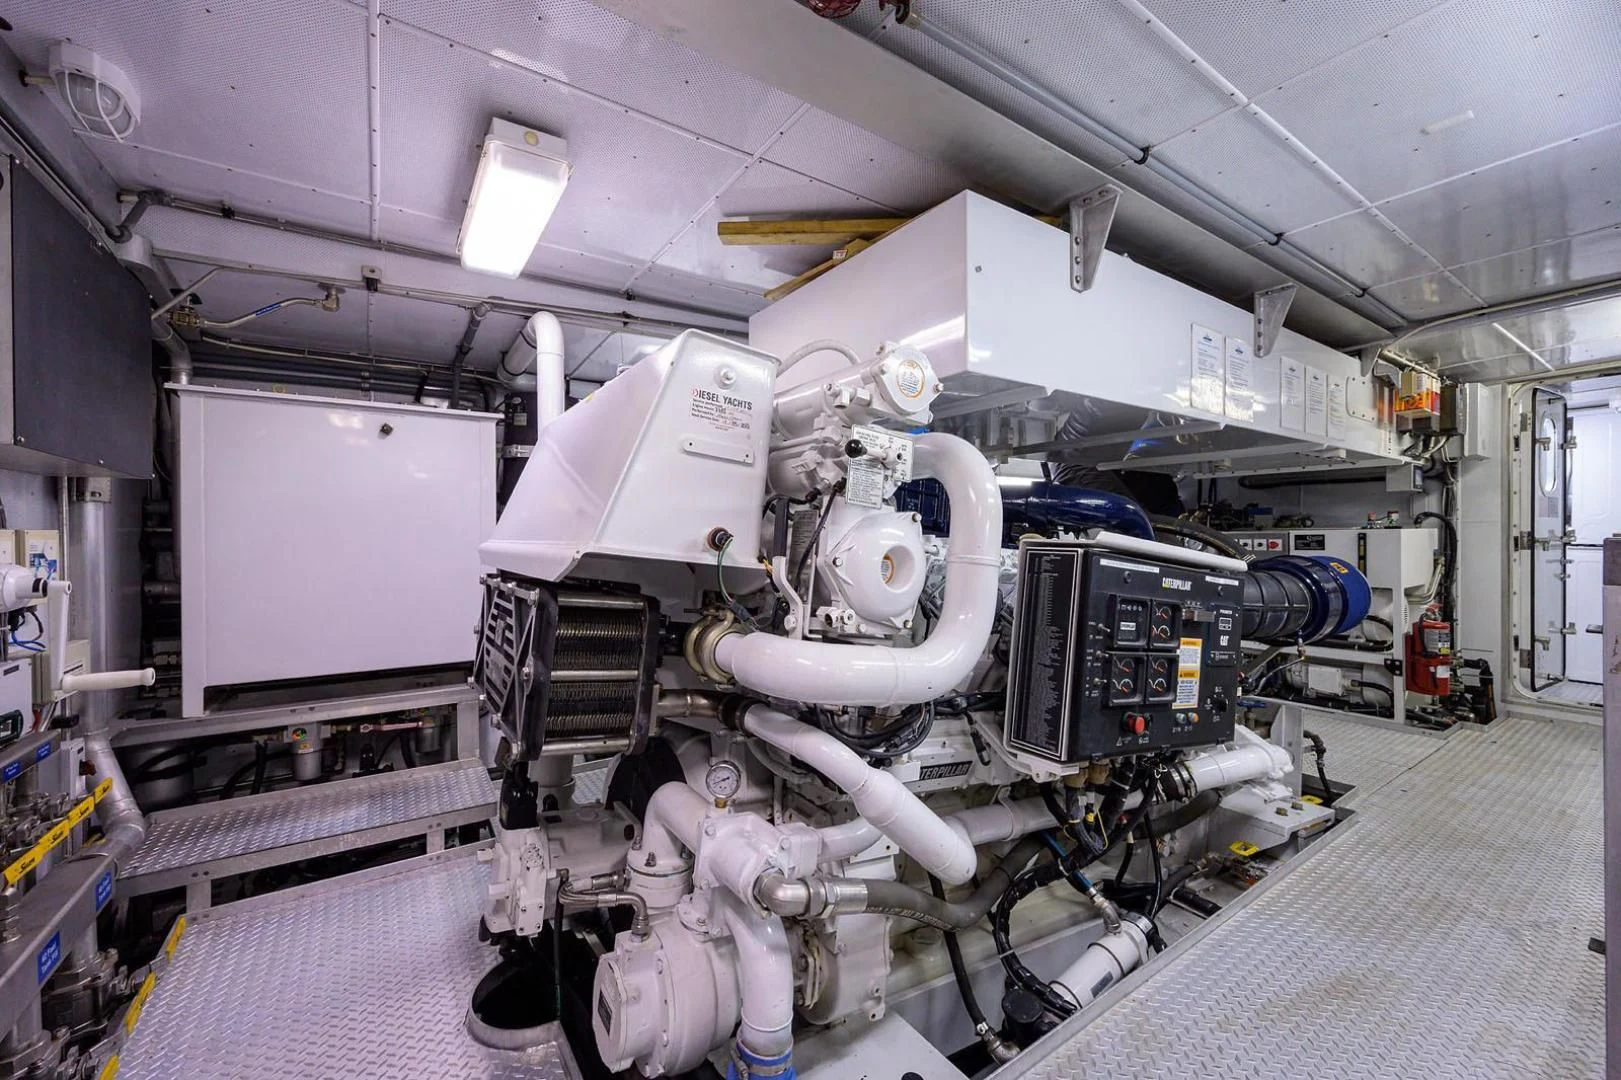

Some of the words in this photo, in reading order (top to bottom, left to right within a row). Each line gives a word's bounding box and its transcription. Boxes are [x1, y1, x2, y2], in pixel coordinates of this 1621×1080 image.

[692, 388, 721, 403] DIESEL
[723, 396, 753, 410] YACHTS
[1162, 577, 1192, 591] CATERPILLAR
[919, 764, 970, 780] TERPILLAR
